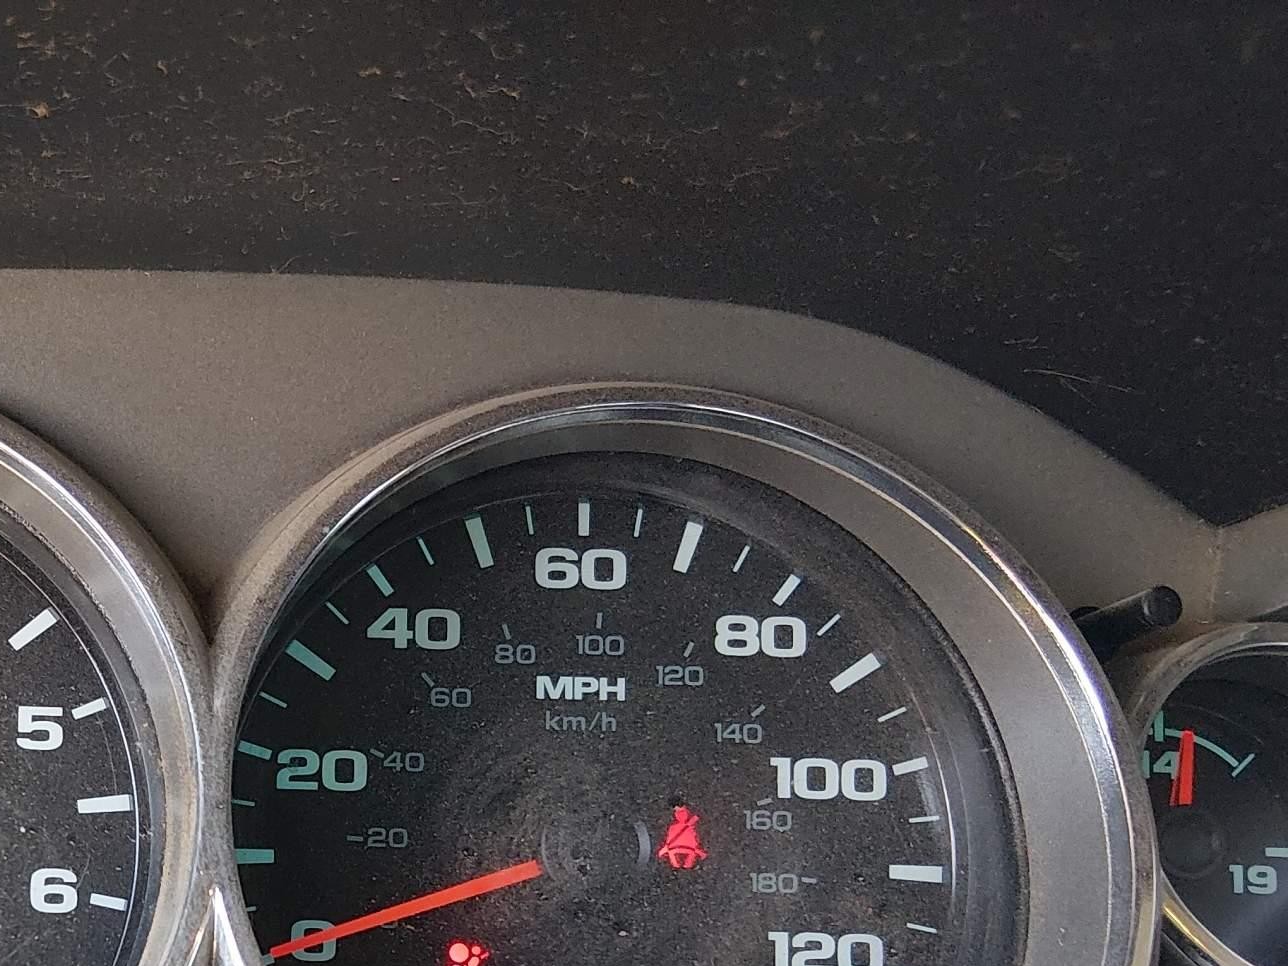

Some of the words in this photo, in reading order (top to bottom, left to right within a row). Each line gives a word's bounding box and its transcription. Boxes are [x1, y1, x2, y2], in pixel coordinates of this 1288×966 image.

[535, 547, 627, 591] 60
[366, 607, 461, 650] 40
[714, 614, 807, 658] 80
[494, 643, 536, 665] 80
[575, 634, 625, 656] 100
[535, 675, 626, 702] MPH
[655, 665, 704, 687] 120
[430, 687, 472, 708] 60
[16, 705, 64, 751] 5
[545, 711, 617, 732] km/h
[713, 722, 763, 744] 140
[276, 748, 368, 792] 20
[383, 751, 425, 773] 40
[769, 756, 888, 801] 100
[743, 809, 793, 832] 160
[367, 827, 410, 848] 20
[29, 867, 78, 914] 6
[749, 872, 799, 895] 180
[1228, 864, 1278, 895] 19
[290, 919, 337, 962] 0
